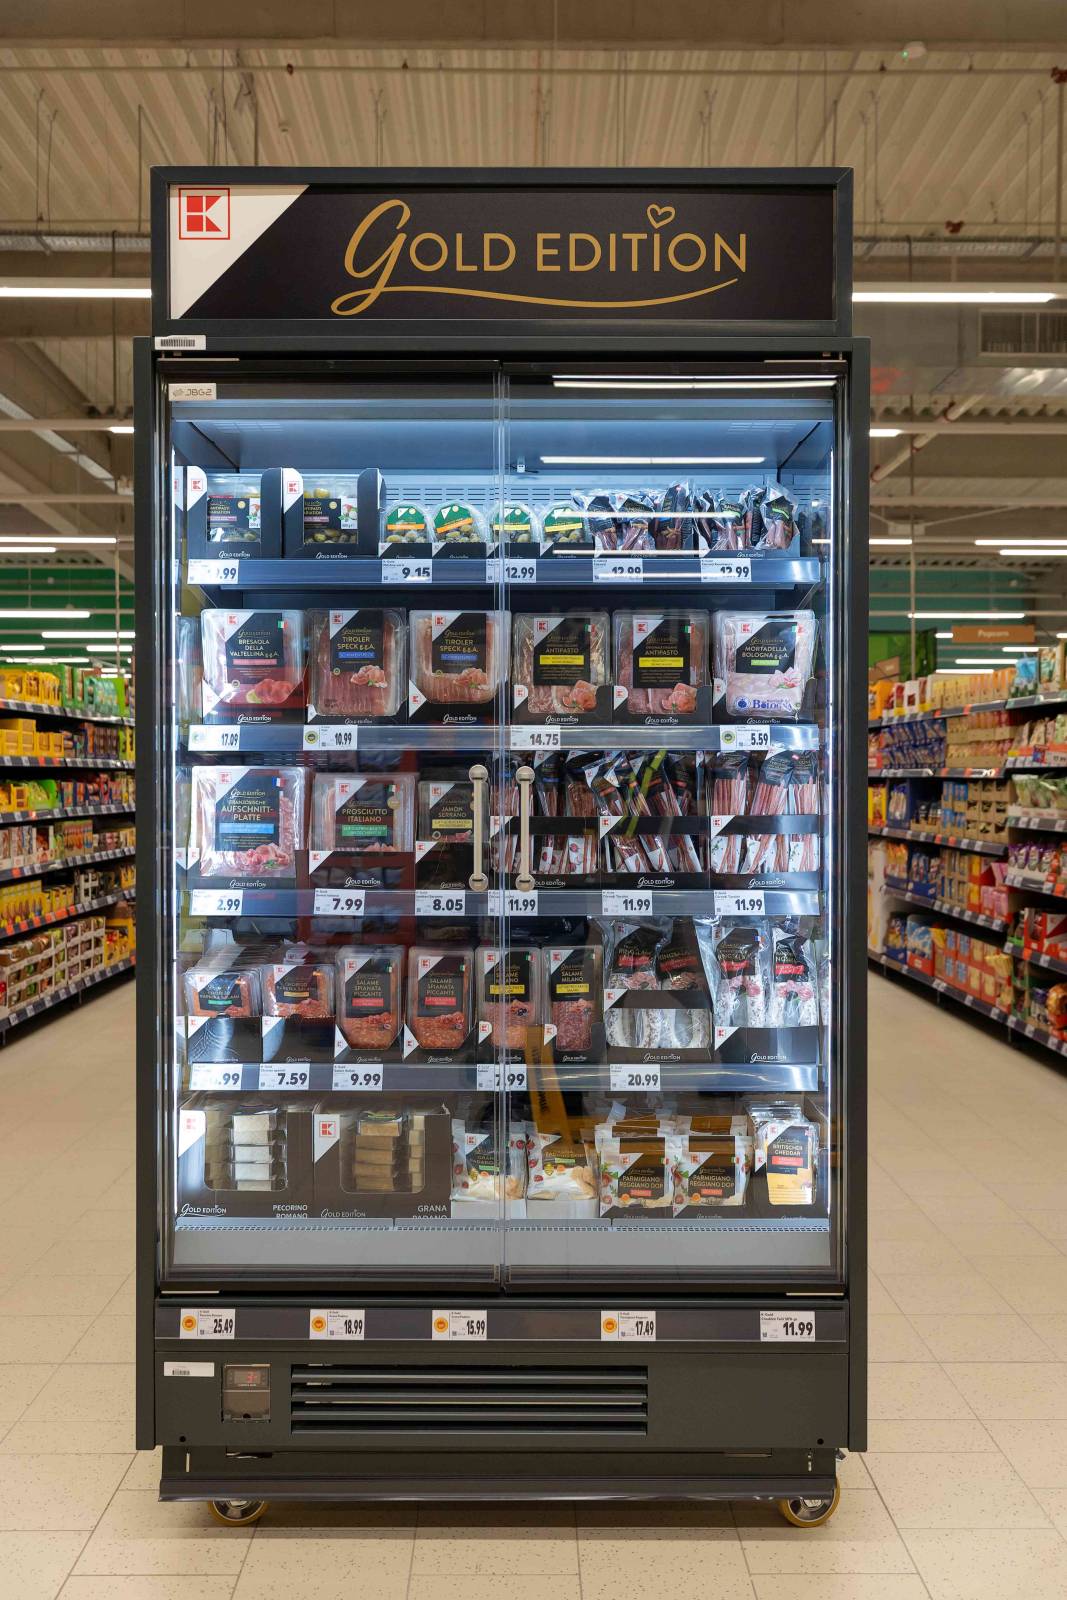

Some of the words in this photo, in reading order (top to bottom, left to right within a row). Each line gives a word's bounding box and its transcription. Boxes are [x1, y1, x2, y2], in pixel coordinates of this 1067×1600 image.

[331, 199, 516, 315] GOLD
[535, 204, 747, 272] EDITION
[402, 567, 430, 579] 9.15
[505, 567, 535, 579] 12.99
[237, 714, 252, 724] GOLD
[253, 714, 272, 722] EDITION
[443, 714, 458, 724] GOLD
[459, 714, 477, 722] EDITION
[545, 715, 560, 724] GOLD
[645, 716, 660, 725] GOLD
[334, 732, 352, 746] 10.99
[529, 733, 559, 746] 14.75
[751, 732, 769, 746] 5.59
[229, 879, 245, 888] GOLD
[245, 879, 267, 887] EDITION
[344, 876, 361, 888] GOLD
[361, 876, 381, 886] EDITION
[637, 876, 654, 888] GOLD
[655, 876, 675, 886] EDITION
[332, 897, 363, 911] 7.99
[432, 898, 463, 911] 8.05
[507, 898, 536, 911] 11.99
[622, 898, 651, 911] 11.99
[735, 898, 763, 911] 11.99
[643, 1052, 660, 1063] GOLD
[661, 1052, 681, 1061] EDITION
[277, 1072, 307, 1086] 7.59
[350, 1073, 381, 1086] 9.99
[627, 1073, 659, 1087] 20.99
[622, 1175, 661, 1183] PARMIGIANO
[180, 1203, 202, 1217] GOLD
[202, 1204, 227, 1214] EDITION
[320, 1208, 341, 1218] GOLD
[341, 1208, 366, 1218] EDITION
[417, 1204, 448, 1212] GRANA
[213, 1318, 234, 1334] 25.49
[343, 1319, 363, 1335] 18.99
[466, 1319, 486, 1335] 15.99
[635, 1320, 655, 1336] 17.49
[783, 1321, 814, 1336] 11.99
